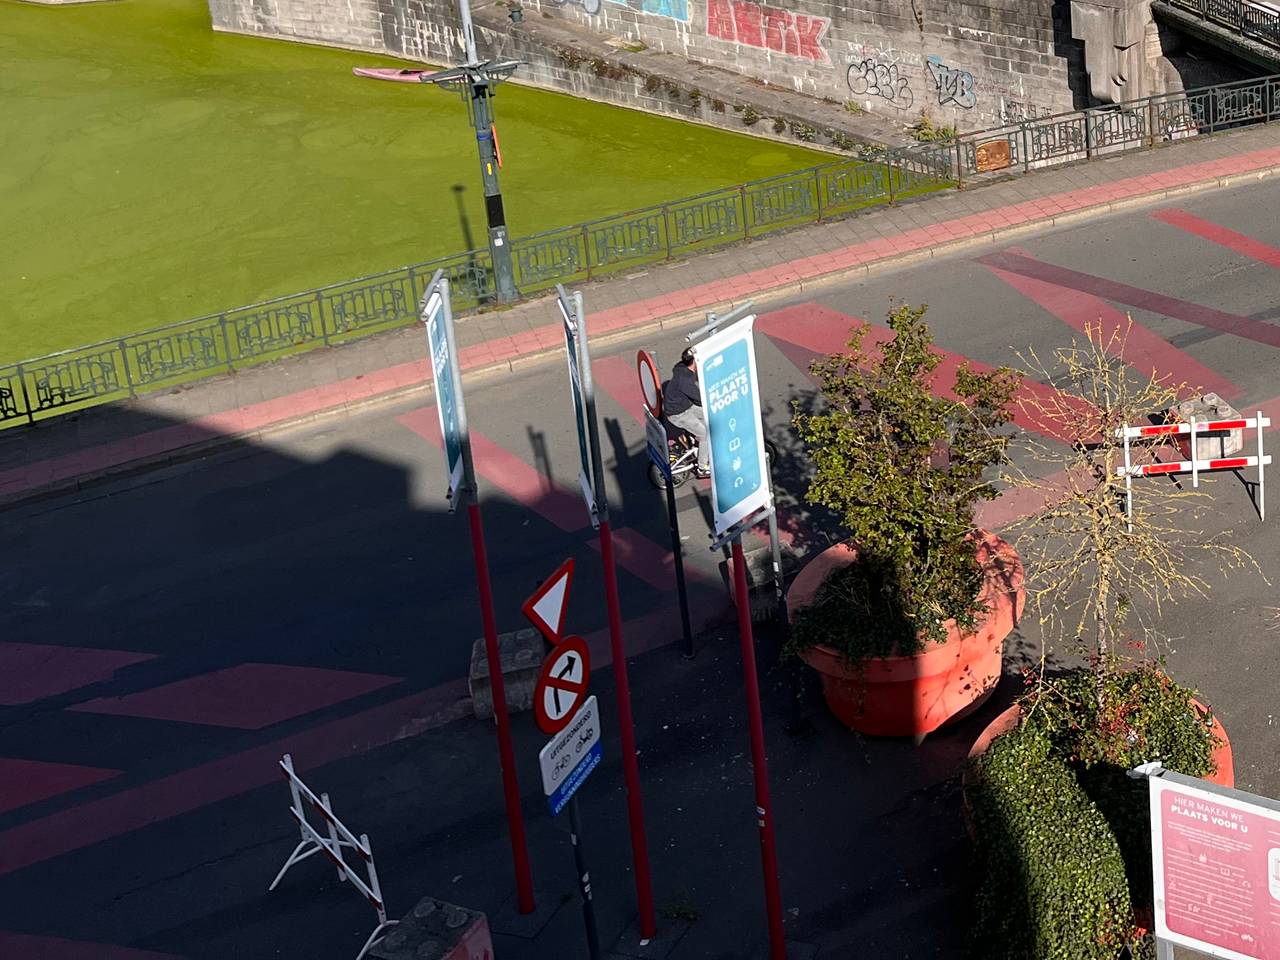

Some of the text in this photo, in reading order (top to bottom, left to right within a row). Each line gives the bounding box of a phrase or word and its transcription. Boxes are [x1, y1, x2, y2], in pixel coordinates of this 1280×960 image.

[708, 373, 748, 404] PLAATS
[710, 384, 749, 414] VOOR U
[550, 710, 592, 760] UITGEZONDERD
[1170, 805, 1248, 833] PLAATS VOOR U
[1174, 796, 1245, 823] HIER MAKEN WE
